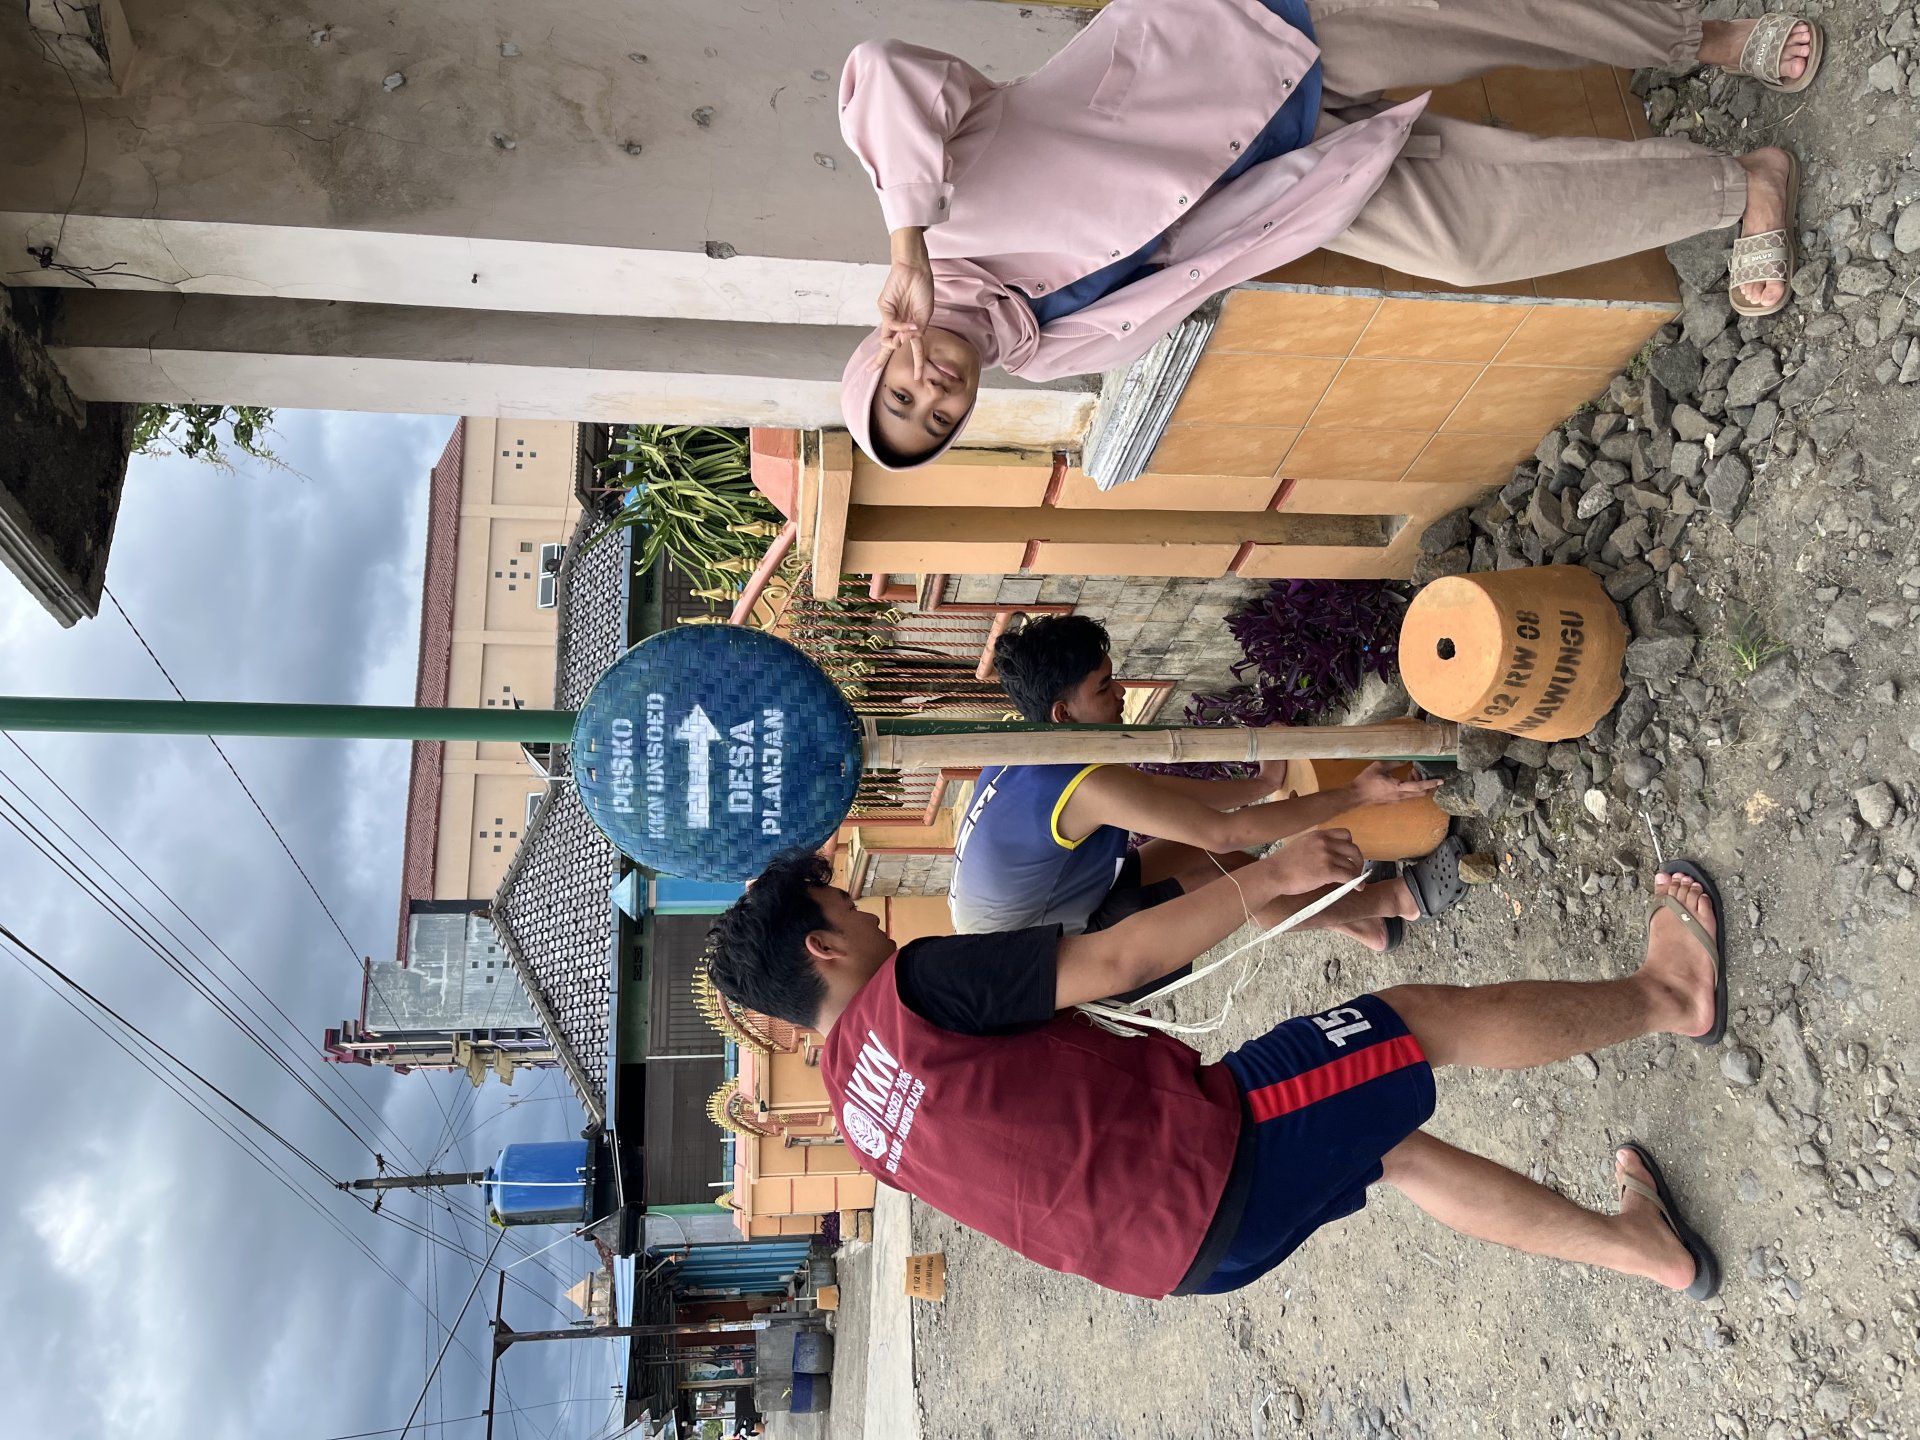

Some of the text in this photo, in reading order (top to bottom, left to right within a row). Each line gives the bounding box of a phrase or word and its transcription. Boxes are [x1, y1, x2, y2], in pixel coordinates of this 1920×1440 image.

[1515, 609, 1541, 641] 08
[1503, 646, 1538, 688] RW
[1503, 609, 1585, 733] AWAWUNGU
[1483, 693, 1520, 716] 02
[611, 717, 634, 814] POSKO
[646, 692, 665, 839] KKN UNSOED
[728, 719, 755, 813] DESA
[761, 708, 784, 836] PLANJAN
[1311, 1007, 1372, 1047] 15
[847, 1029, 899, 1115] KKN
[906, 1078, 926, 1109] CILACAP
[884, 1090, 903, 1128] UNSOED
